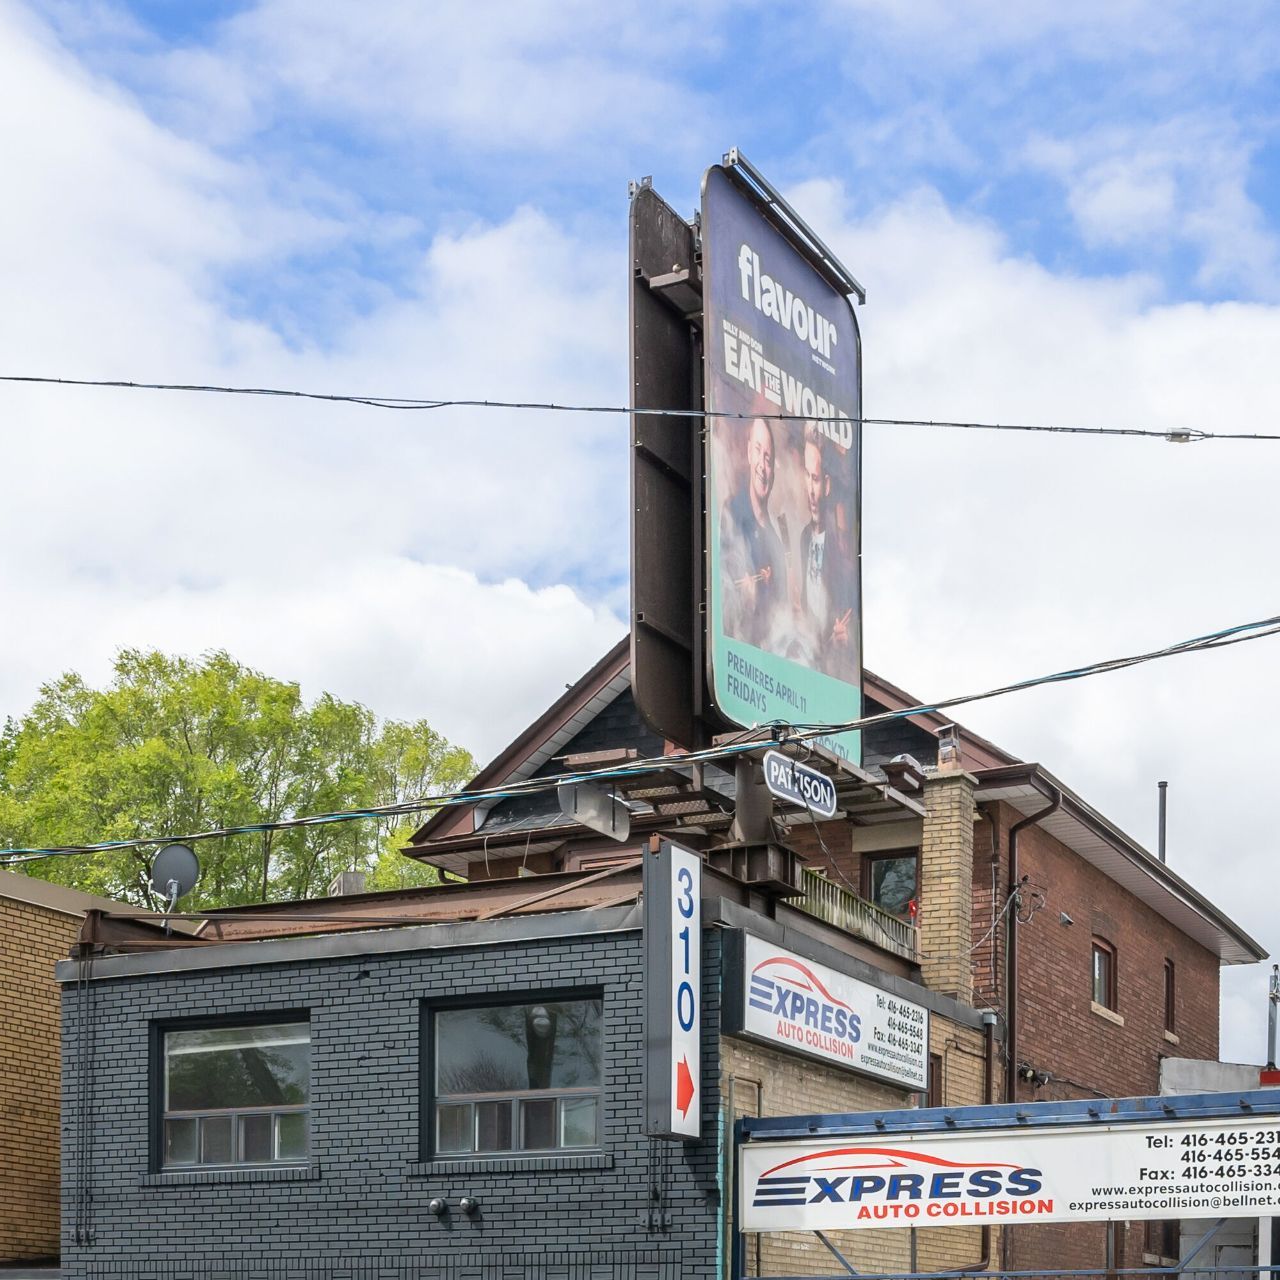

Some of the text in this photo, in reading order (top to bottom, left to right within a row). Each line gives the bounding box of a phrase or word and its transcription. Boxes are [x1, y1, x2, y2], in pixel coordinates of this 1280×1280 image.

[738, 244, 838, 359] flavour
[723, 331, 853, 450] EAT THE WORLD
[727, 650, 807, 713] PREMIERES APRIL 11
[727, 673, 767, 713] FRIDAYS
[677, 867, 695, 1032] 310
[749, 973, 861, 1043] EXPRESS
[777, 1020, 854, 1059] AUTO COLLISION
[1146, 1135, 1174, 1149] Tel:
[752, 1168, 1043, 1207] EXPRESS
[1139, 1166, 1175, 1181] Fax:
[857, 1199, 1054, 1219] AUTO COLLISION
